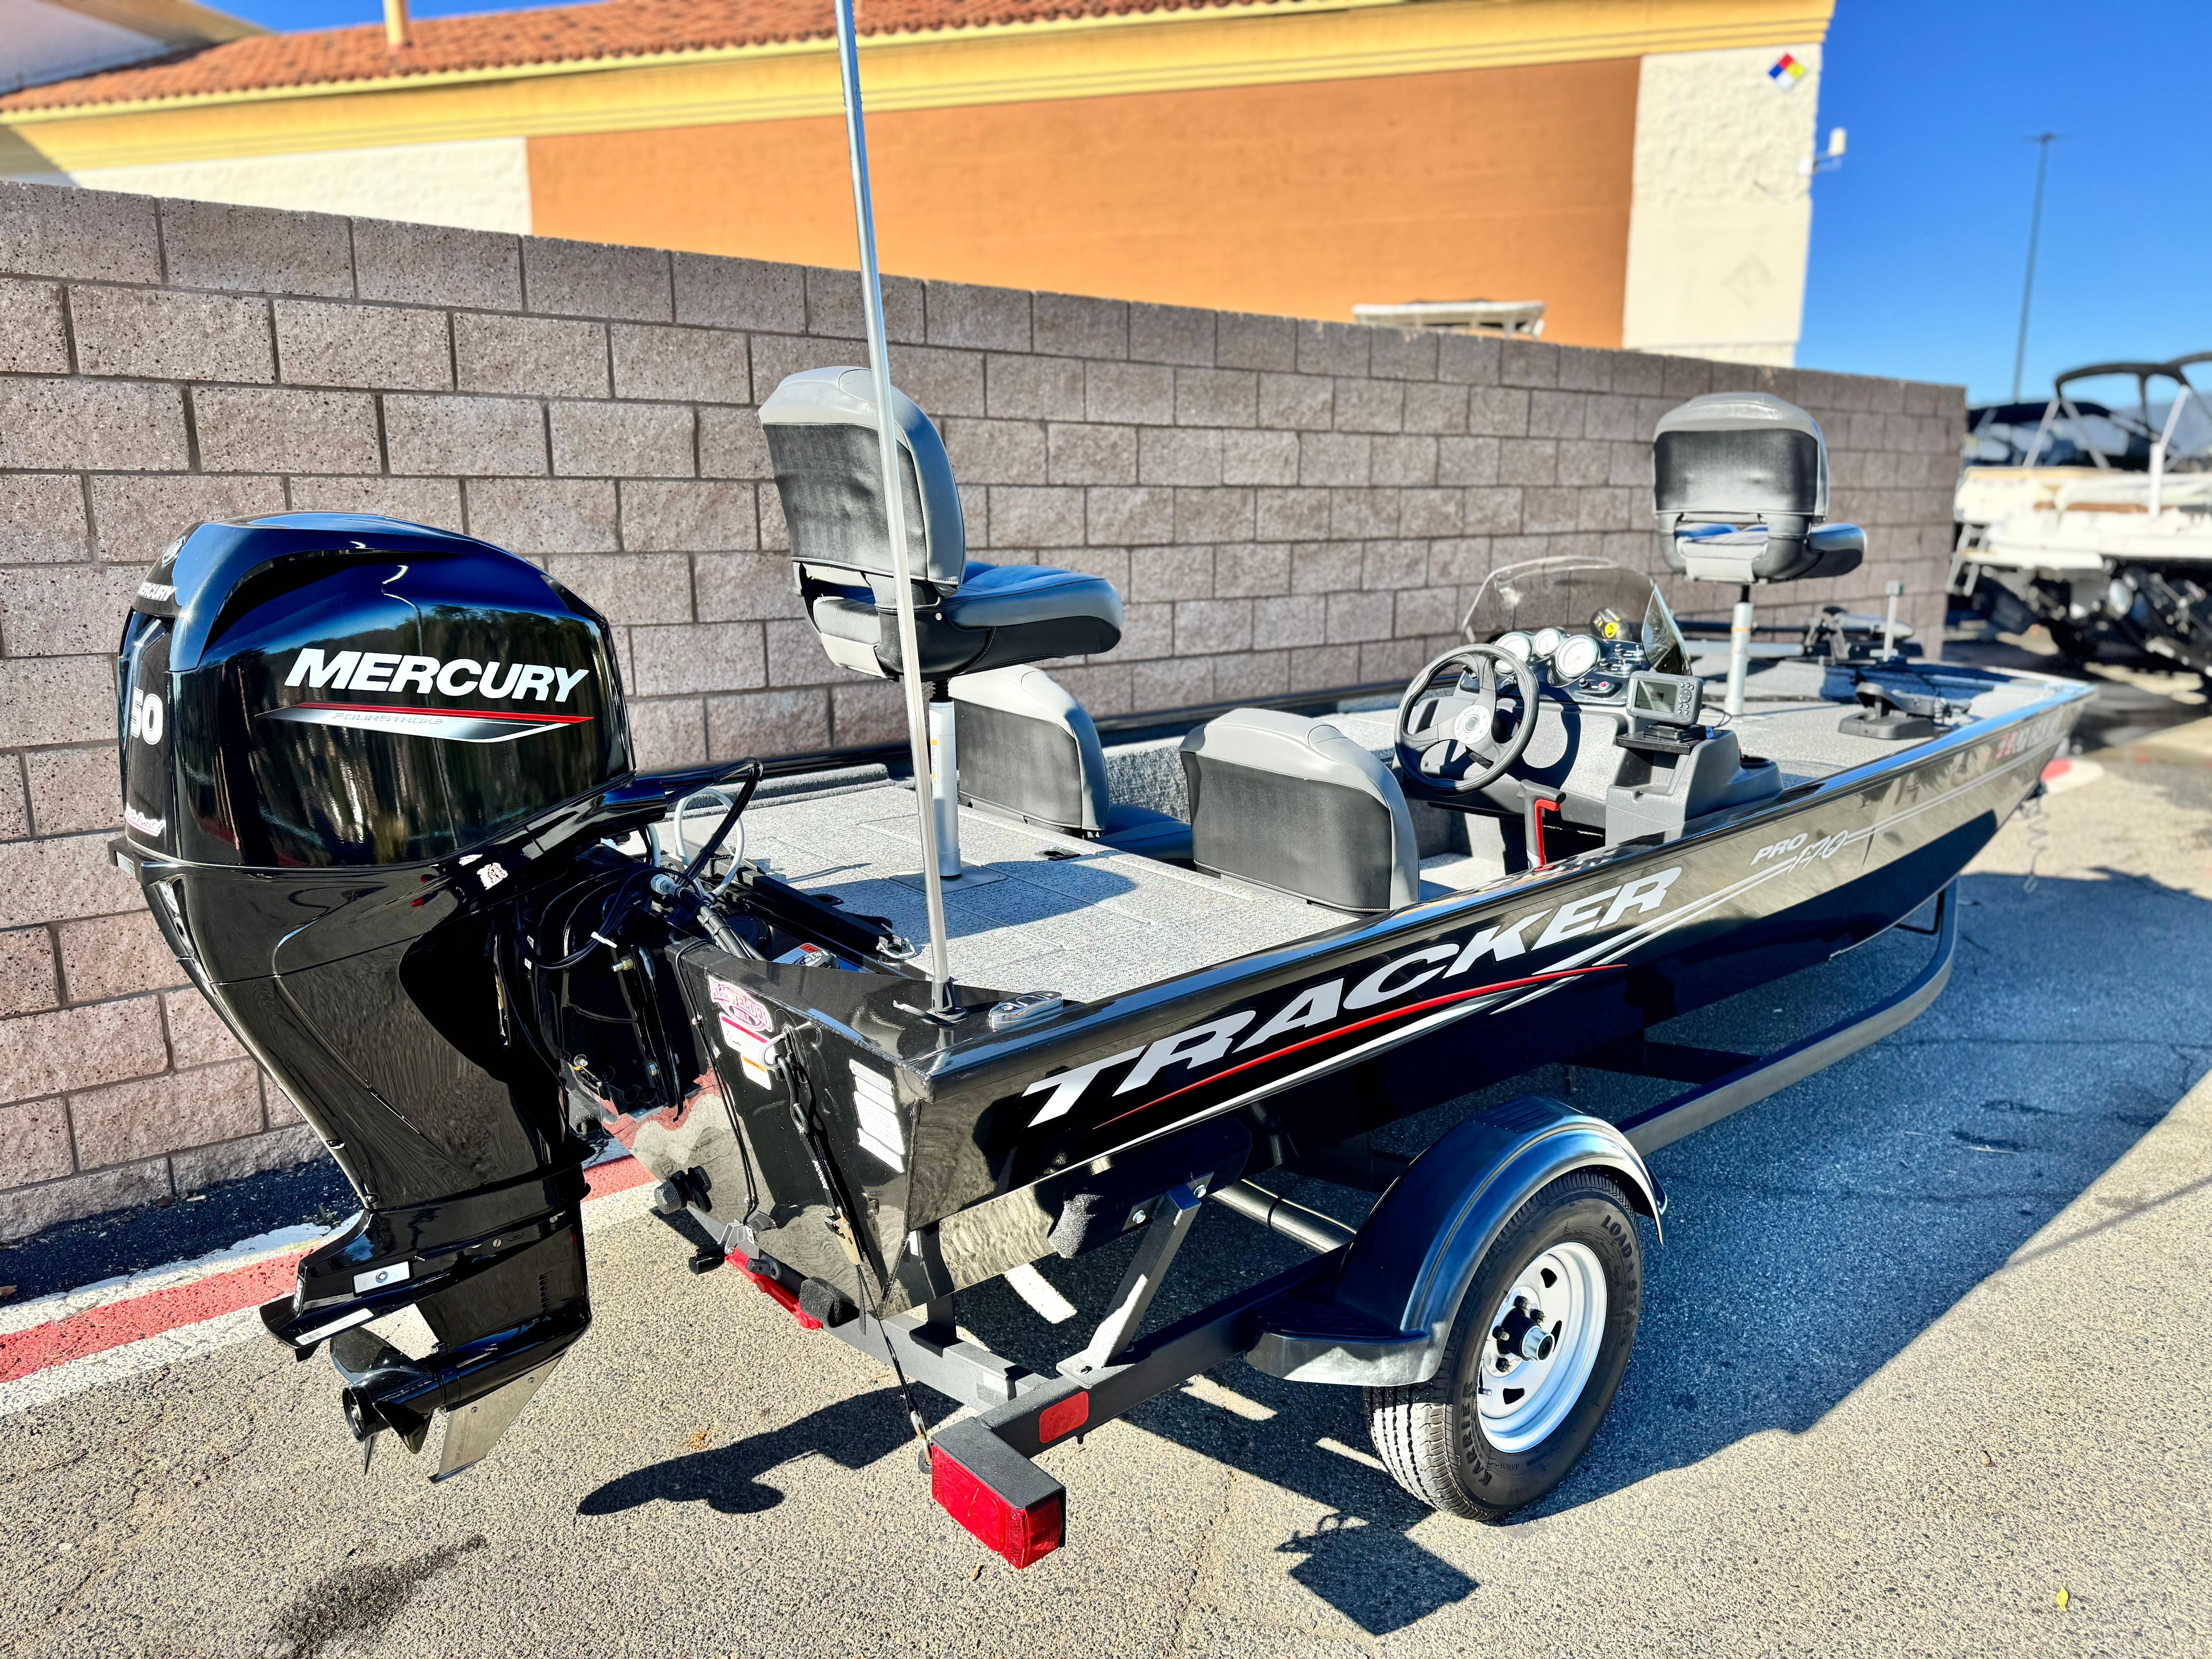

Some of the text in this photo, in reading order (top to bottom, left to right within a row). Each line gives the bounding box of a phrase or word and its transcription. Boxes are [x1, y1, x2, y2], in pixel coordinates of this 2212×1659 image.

[284, 648, 589, 702] MERCURY
[131, 686, 163, 745] 50
[1750, 830, 1848, 874] PRO 170
[733, 1007, 754, 1025] HULL
[1022, 866, 1682, 1128] TRACKER
[1601, 1214, 1632, 1258] LOAD
[1461, 1381, 1492, 1486] KARRIER
